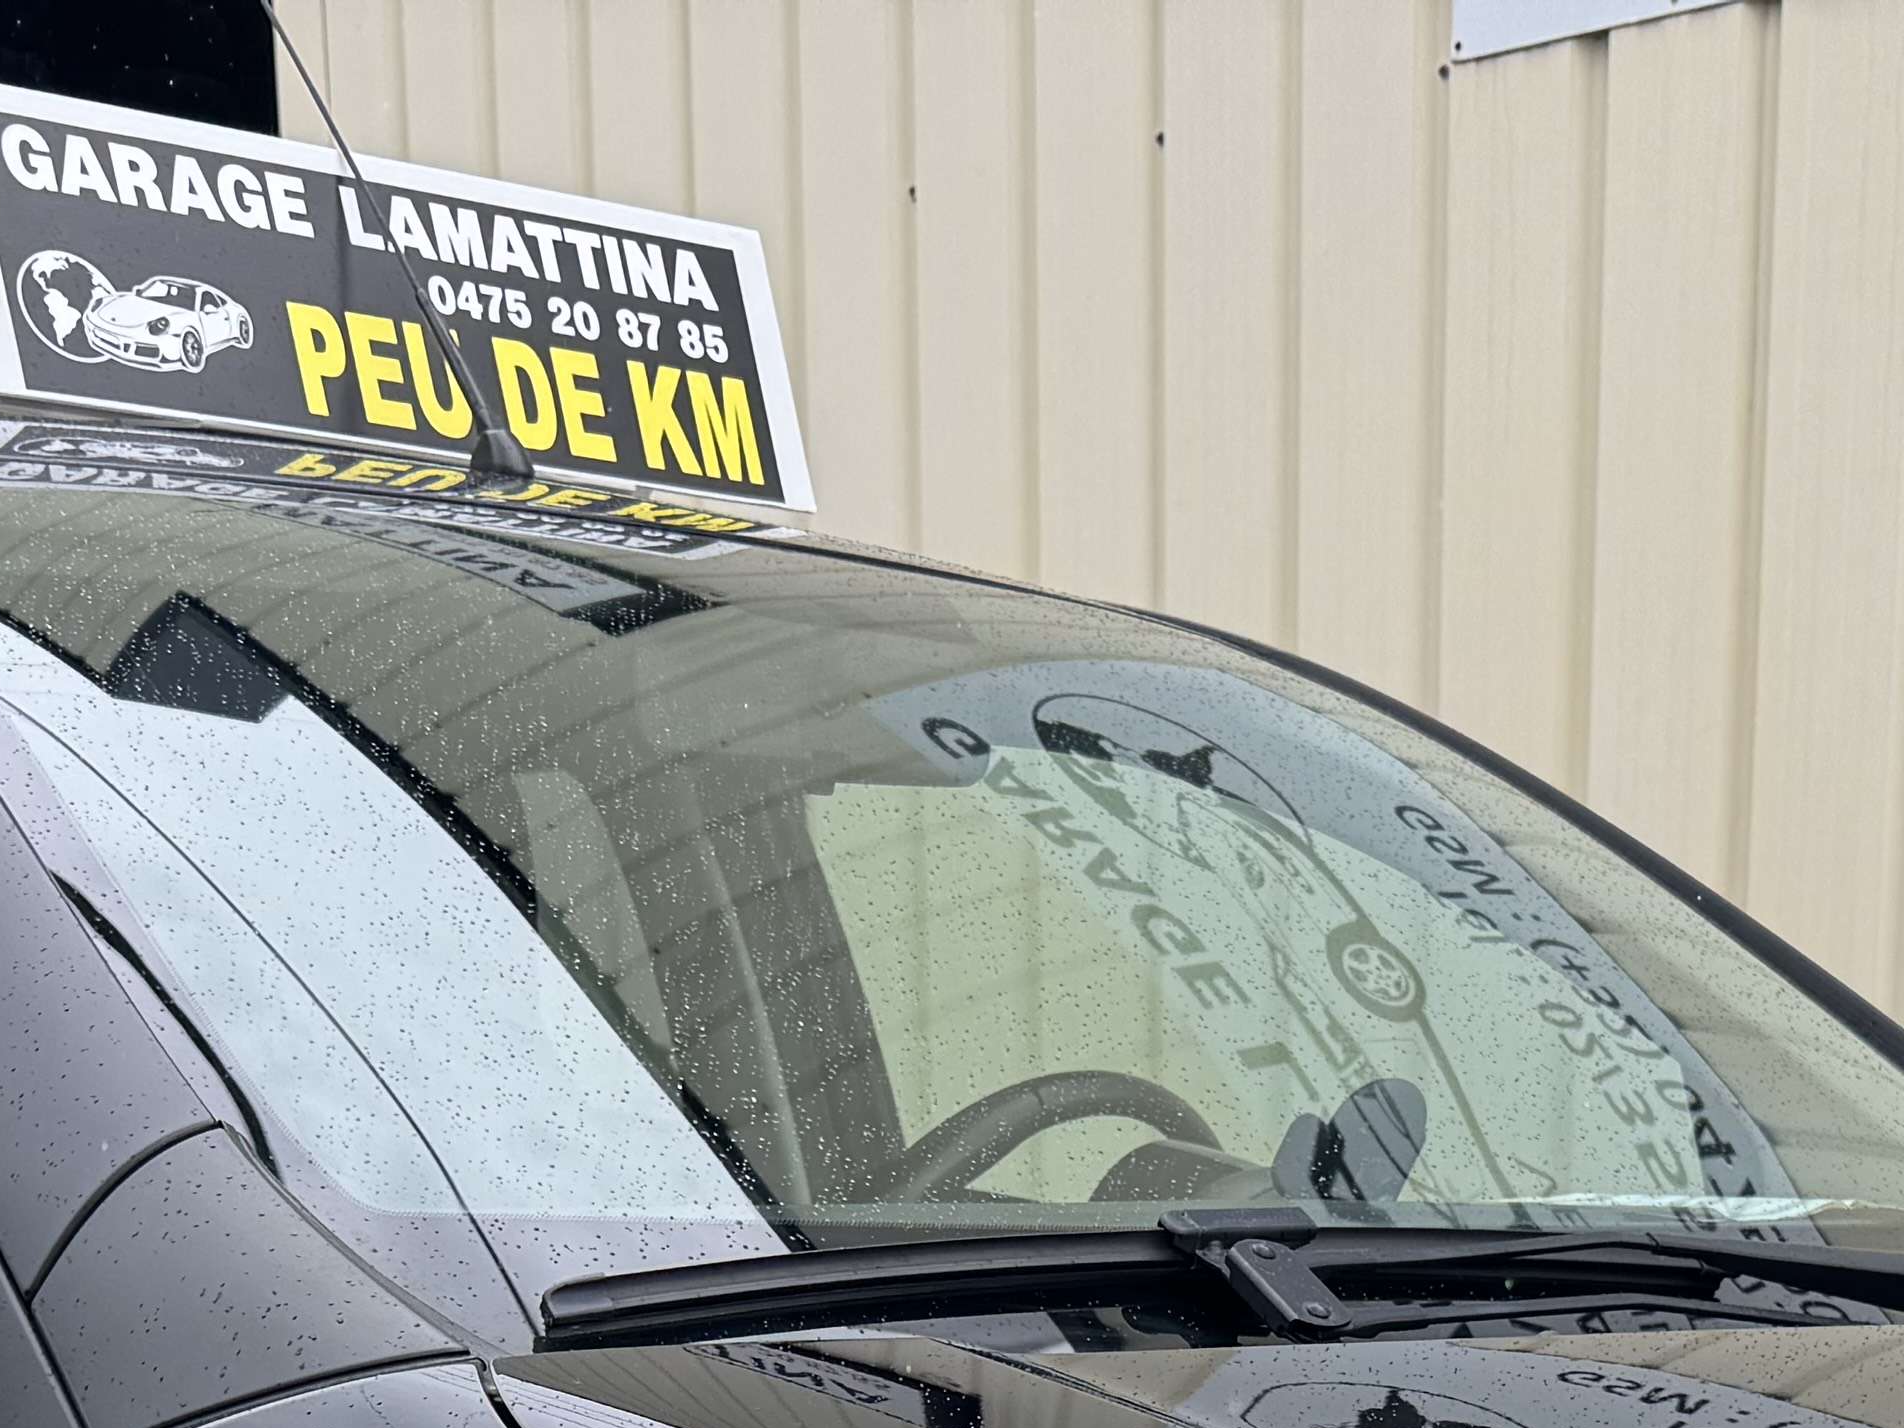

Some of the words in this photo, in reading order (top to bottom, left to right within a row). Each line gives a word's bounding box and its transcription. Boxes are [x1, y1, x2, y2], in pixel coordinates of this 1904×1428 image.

[1, 123, 315, 239] GARAGE
[337, 185, 720, 312] LAMATTINA
[286, 301, 475, 440] PEU
[491, 336, 618, 464] DE
[626, 360, 765, 486] KM
[428, 275, 532, 329] 0475
[547, 296, 601, 341] 20
[615, 308, 662, 352] 87
[677, 320, 729, 364] 85
